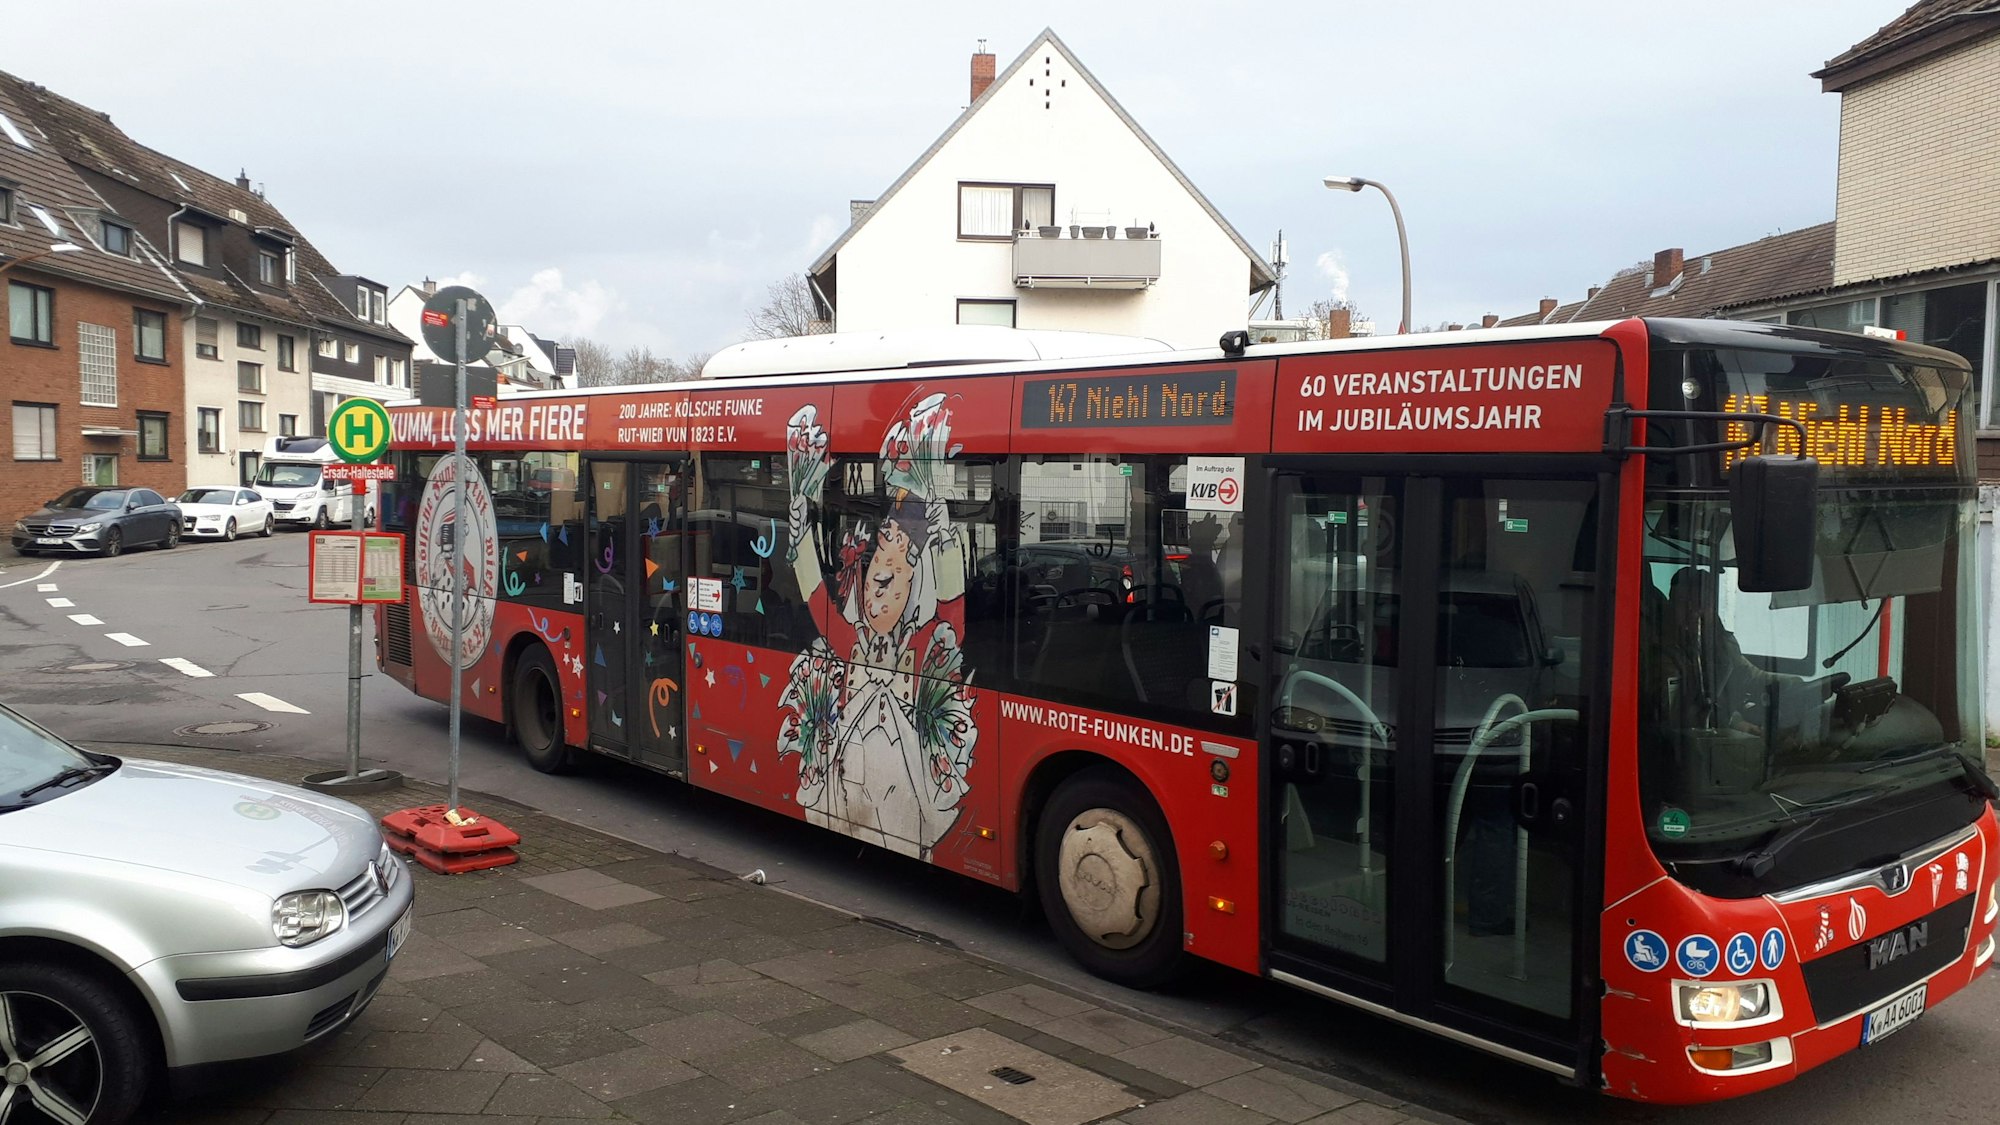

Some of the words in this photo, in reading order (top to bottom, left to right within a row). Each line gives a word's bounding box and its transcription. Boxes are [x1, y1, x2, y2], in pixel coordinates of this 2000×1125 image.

[1300, 375, 1326, 397] 60
[1333, 363, 1583, 396] VERANSTALTUNGEN
[619, 403, 636, 419] 200
[637, 402, 673, 418] JAHRE:
[674, 397, 722, 418] KÖLSCHE
[724, 398, 763, 416] FUNKE
[1049, 383, 1078, 422] 147
[1087, 384, 1148, 419] Niehl
[1161, 380, 1226, 417] Nord
[1298, 410, 1324, 431] IM
[1329, 402, 1543, 431] JUBILÄUMSJAHR
[345, 413, 373, 448] H
[390, 412, 437, 447] KUMM,
[486, 407, 524, 441] MER
[529, 404, 587, 441] FIERE
[665, 427, 687, 443] VUN
[690, 427, 714, 443] 1823
[717, 426, 737, 443] E.V.
[1776, 402, 1868, 465] Niehl
[1877, 406, 1956, 465] Nord
[322, 465, 395, 480] Ersatz-Haltestelle
[1204, 465, 1224, 474] Auftrag
[1190, 483, 1218, 498] KVB
[1000, 699, 1194, 757] WWW.ROTE-FUNKEN.DE
[1869, 921, 1928, 970] MAN
[1869, 1013, 1879, 1038] K
[1882, 1003, 1898, 1031] AA
[1898, 989, 1925, 1021] 6001
